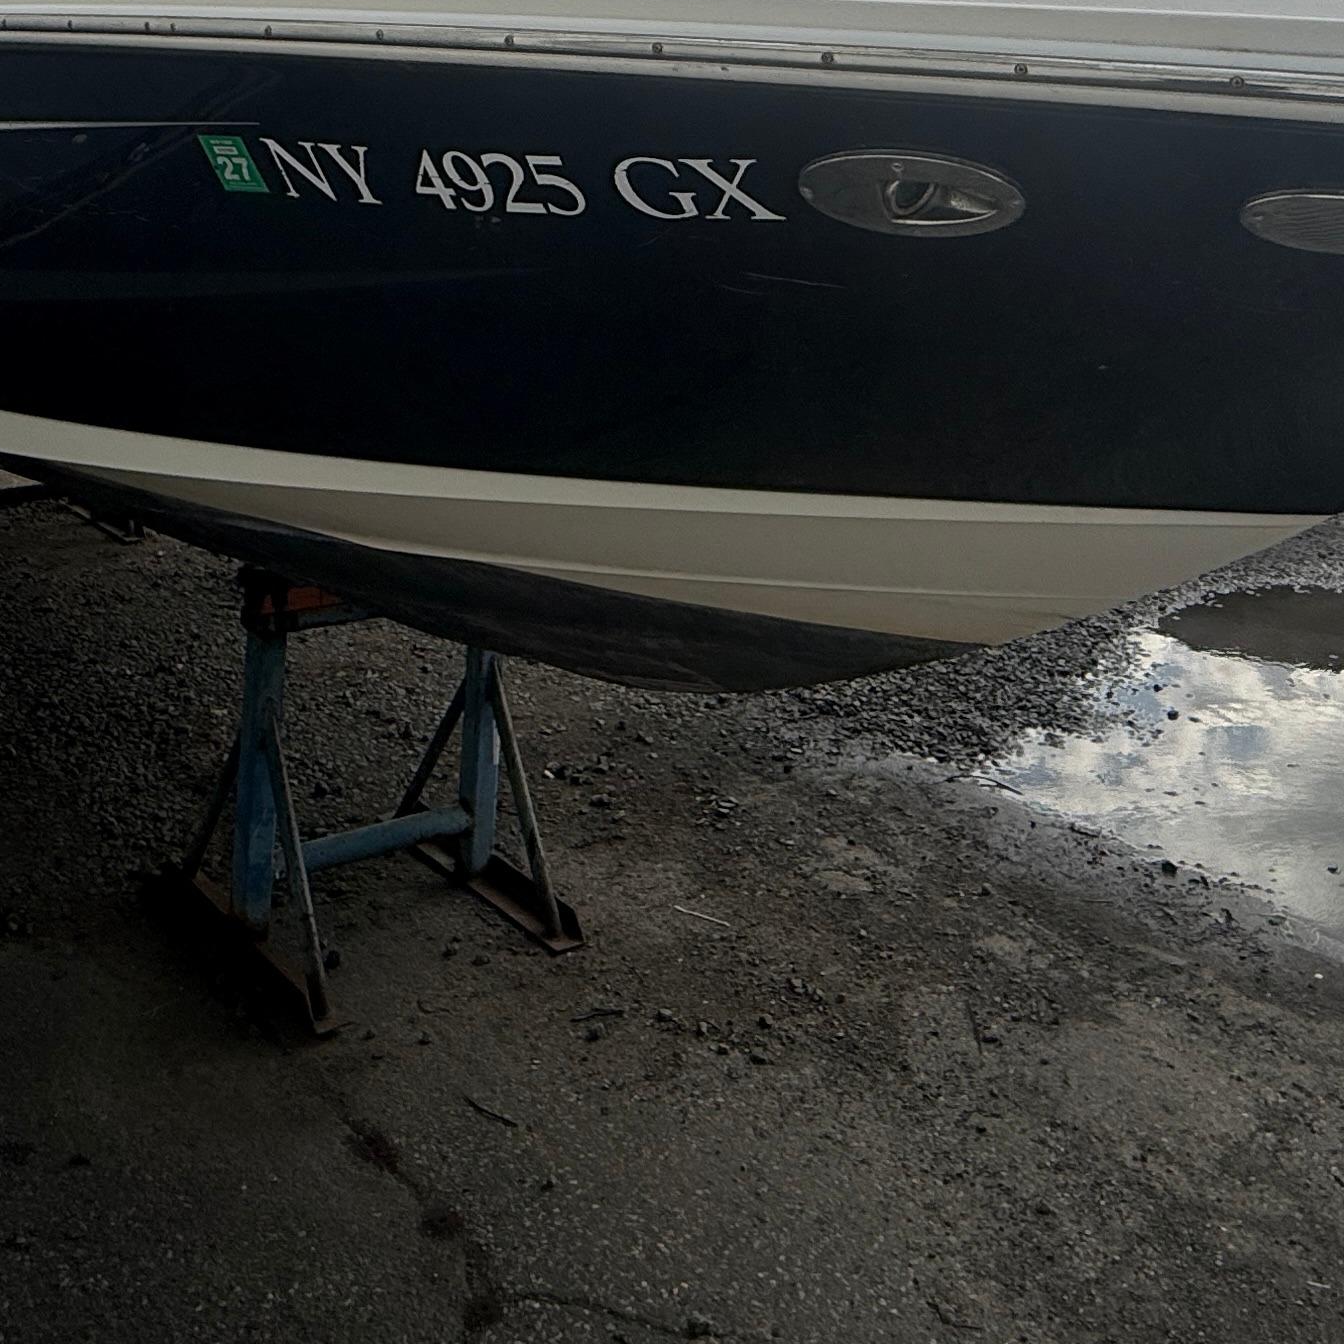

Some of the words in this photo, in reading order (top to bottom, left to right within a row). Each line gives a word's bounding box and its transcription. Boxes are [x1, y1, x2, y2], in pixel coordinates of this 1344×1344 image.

[216, 156, 251, 181] 27
[259, 137, 382, 205] NY
[415, 149, 586, 216] 4925
[613, 156, 787, 220] GX
